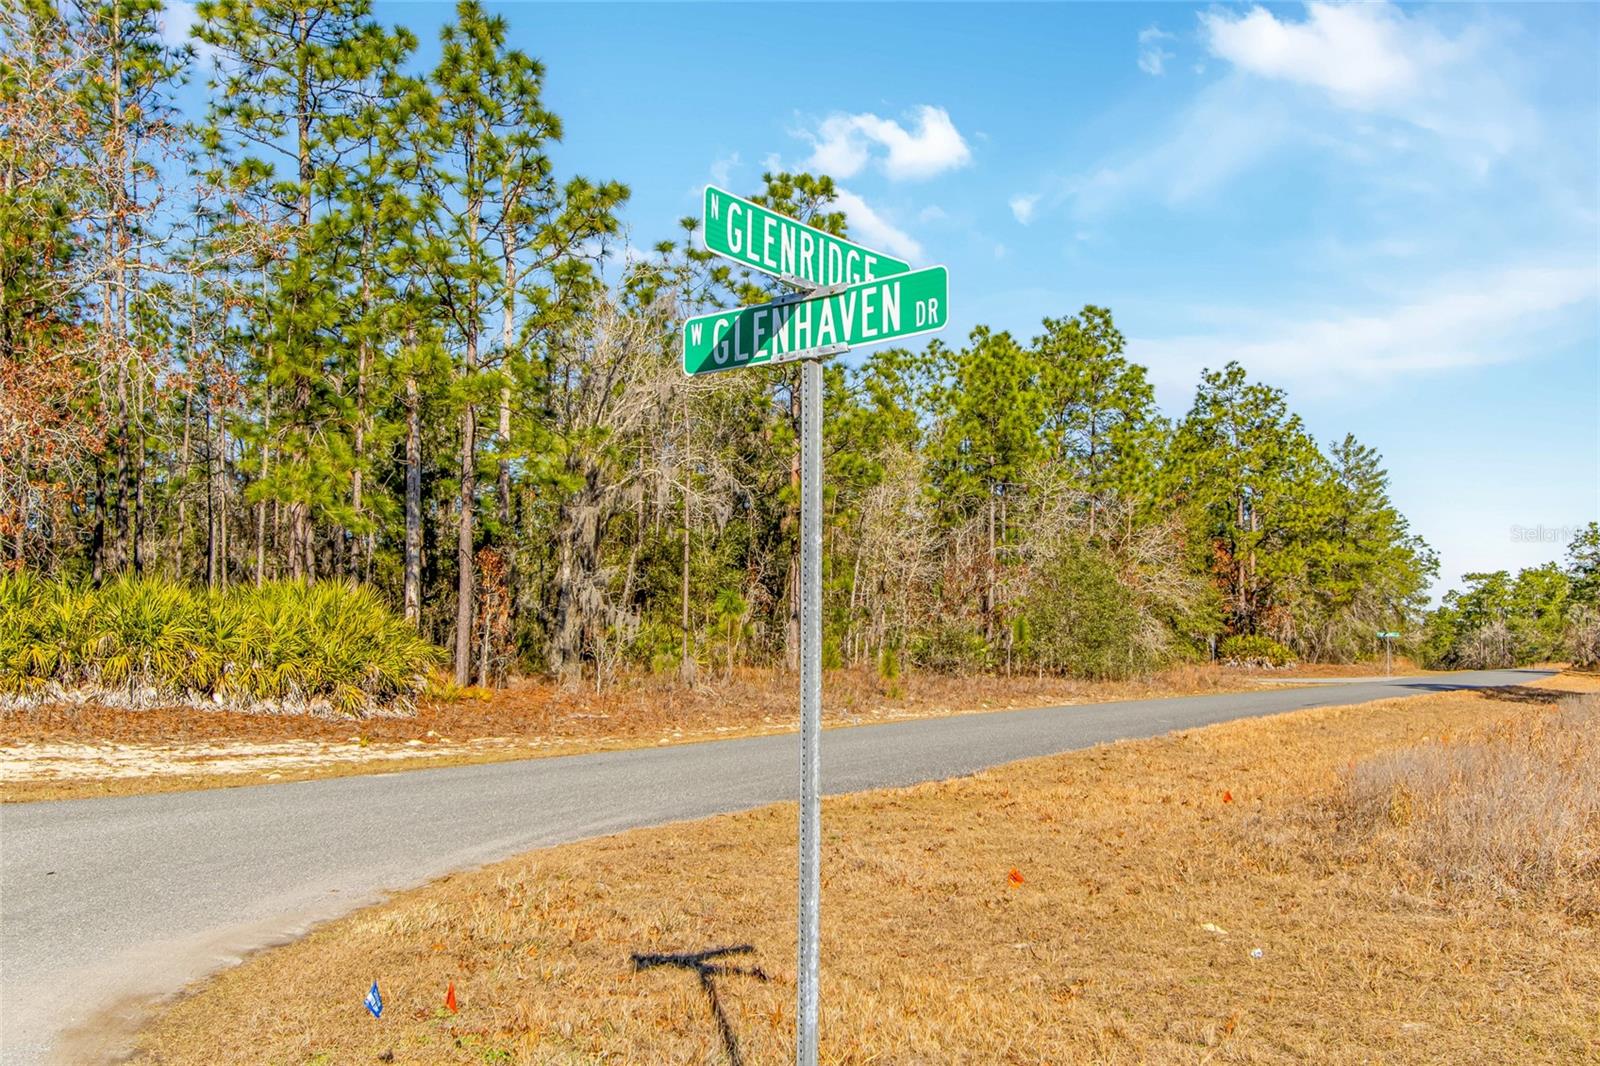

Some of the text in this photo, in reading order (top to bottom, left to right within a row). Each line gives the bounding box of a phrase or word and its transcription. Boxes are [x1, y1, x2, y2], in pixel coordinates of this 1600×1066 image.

[710, 193, 719, 221] N
[691, 281, 938, 365] W GLENHAVEN DR
